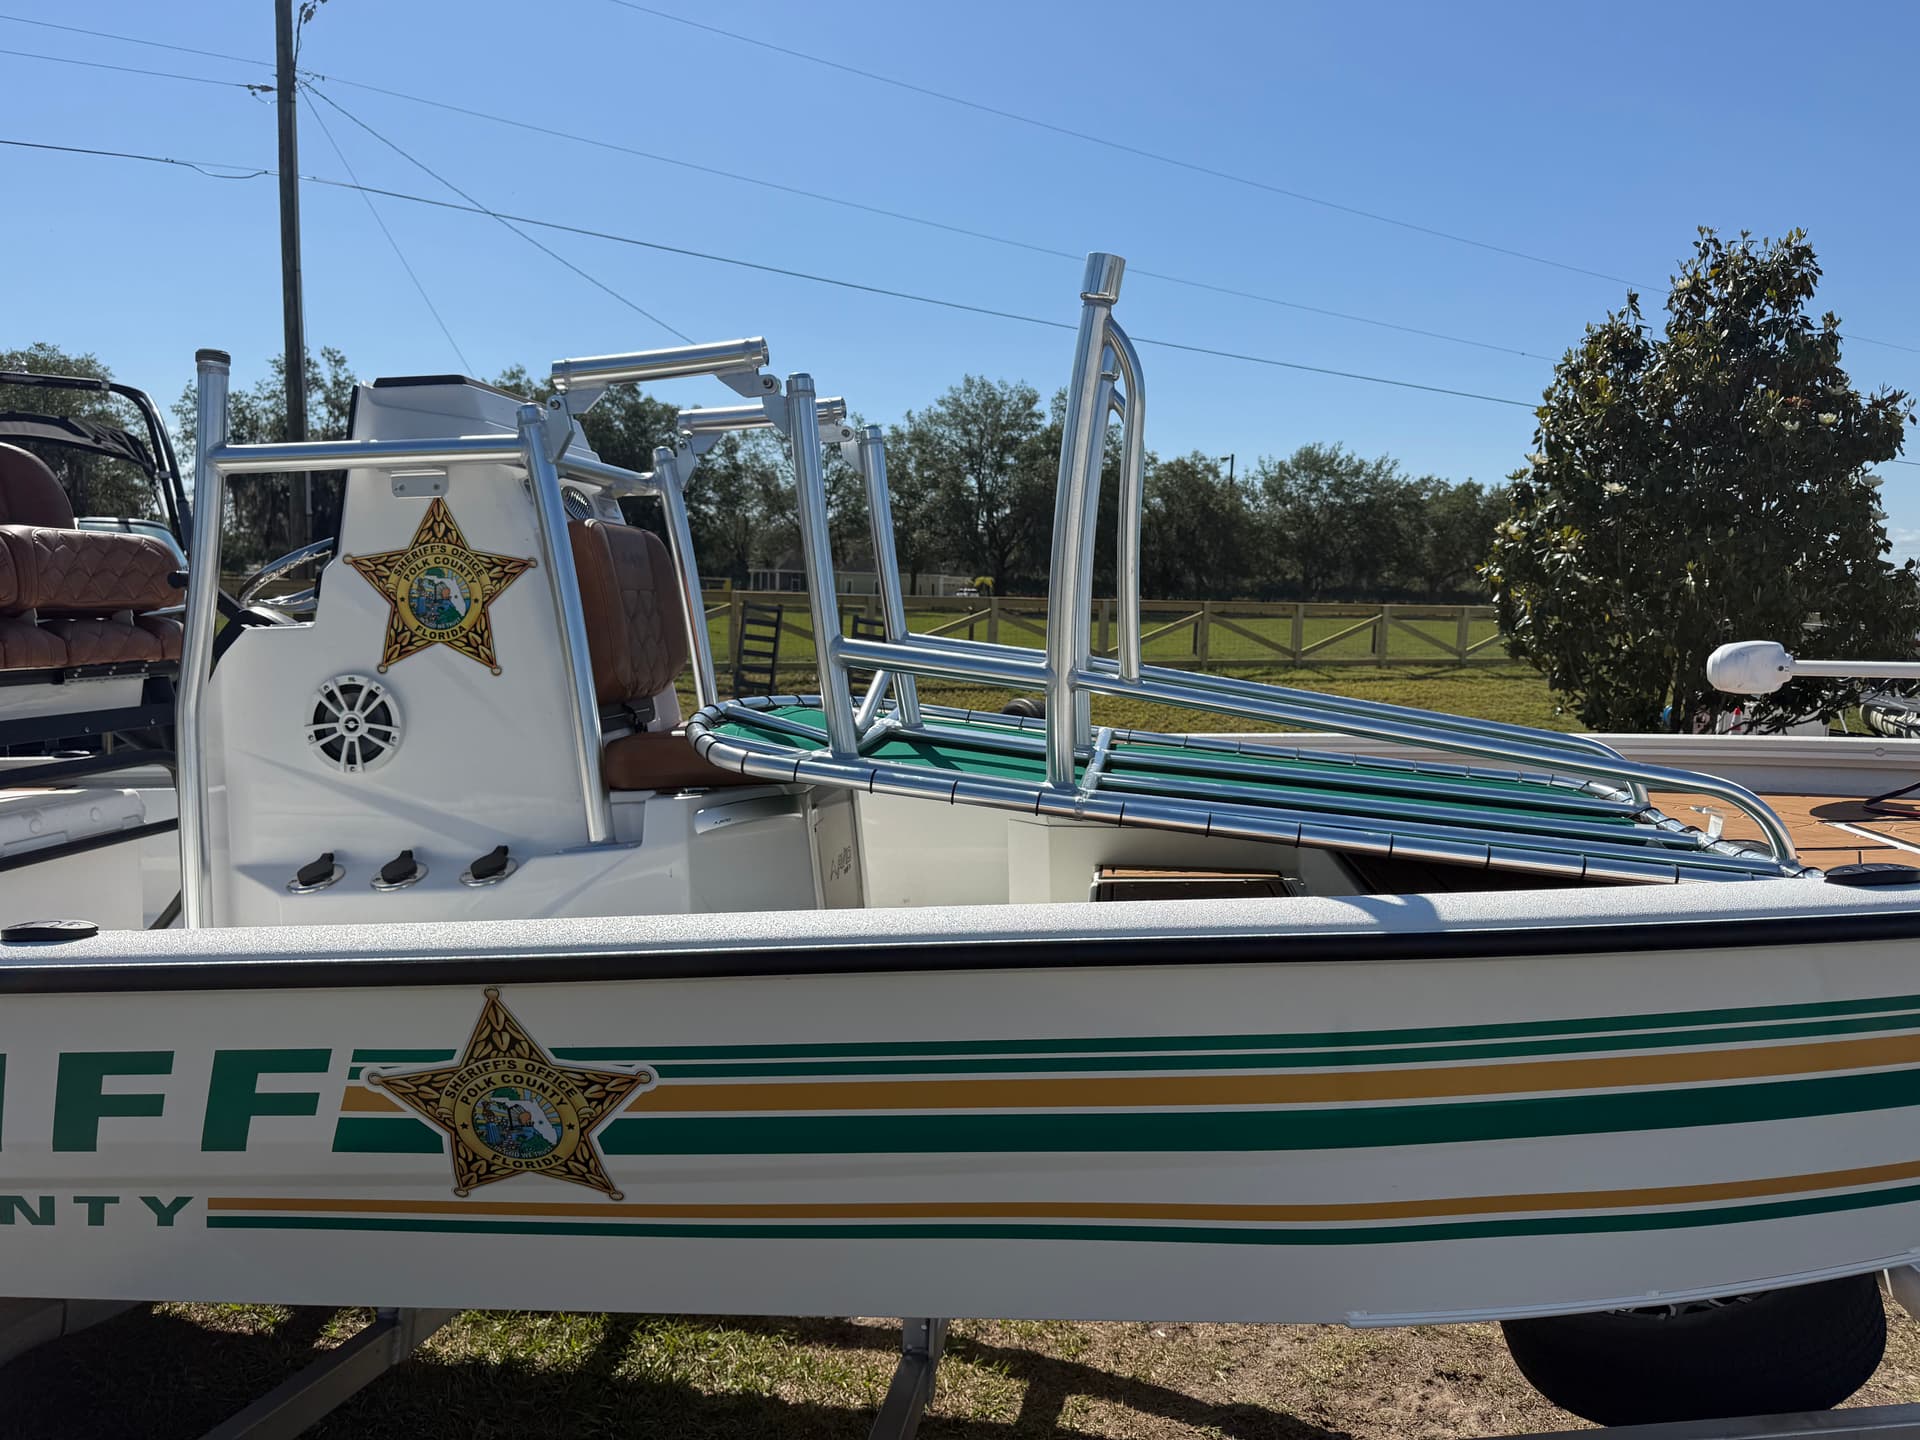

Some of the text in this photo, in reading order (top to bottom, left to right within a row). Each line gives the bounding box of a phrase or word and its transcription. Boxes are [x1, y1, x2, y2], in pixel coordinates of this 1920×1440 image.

[393, 545, 485, 577] SHERIFF'S OFFICE
[403, 556, 477, 585] POLK COUNTY
[415, 624, 466, 640] FLORIDA
[445, 1060, 578, 1099] SHERIFF'S OFFICE
[461, 1074, 569, 1108] POLK COUNTY
[0, 1048, 332, 1152] FF
[491, 1154, 563, 1169] FLORIDA
[0, 1195, 194, 1226] NTY
